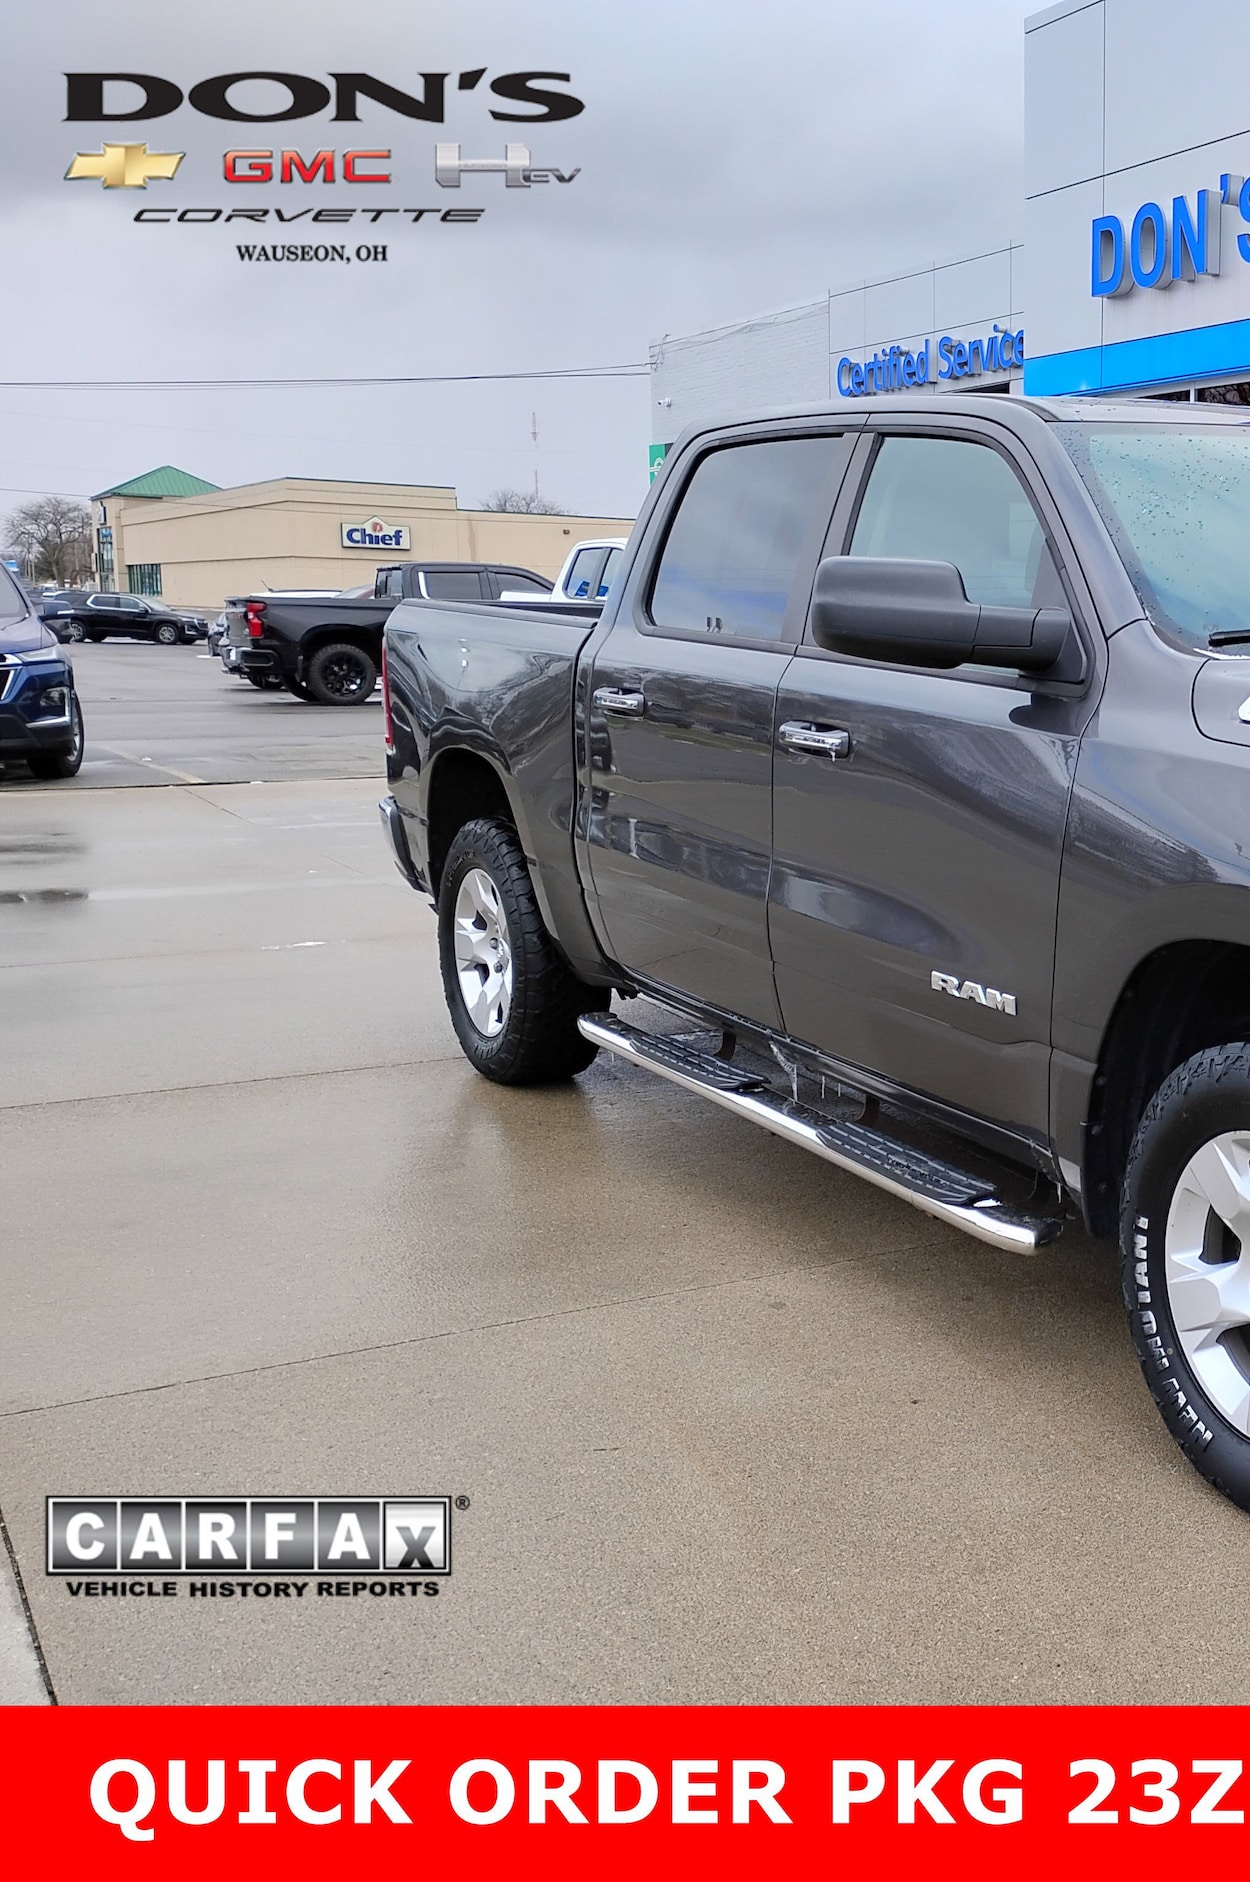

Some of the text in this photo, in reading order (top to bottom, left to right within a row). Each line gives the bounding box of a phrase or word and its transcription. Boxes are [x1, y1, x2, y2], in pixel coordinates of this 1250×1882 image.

[836, 323, 1025, 398] Certified Service
[345, 527, 403, 547] Chief
[930, 970, 1017, 1016] RAM
